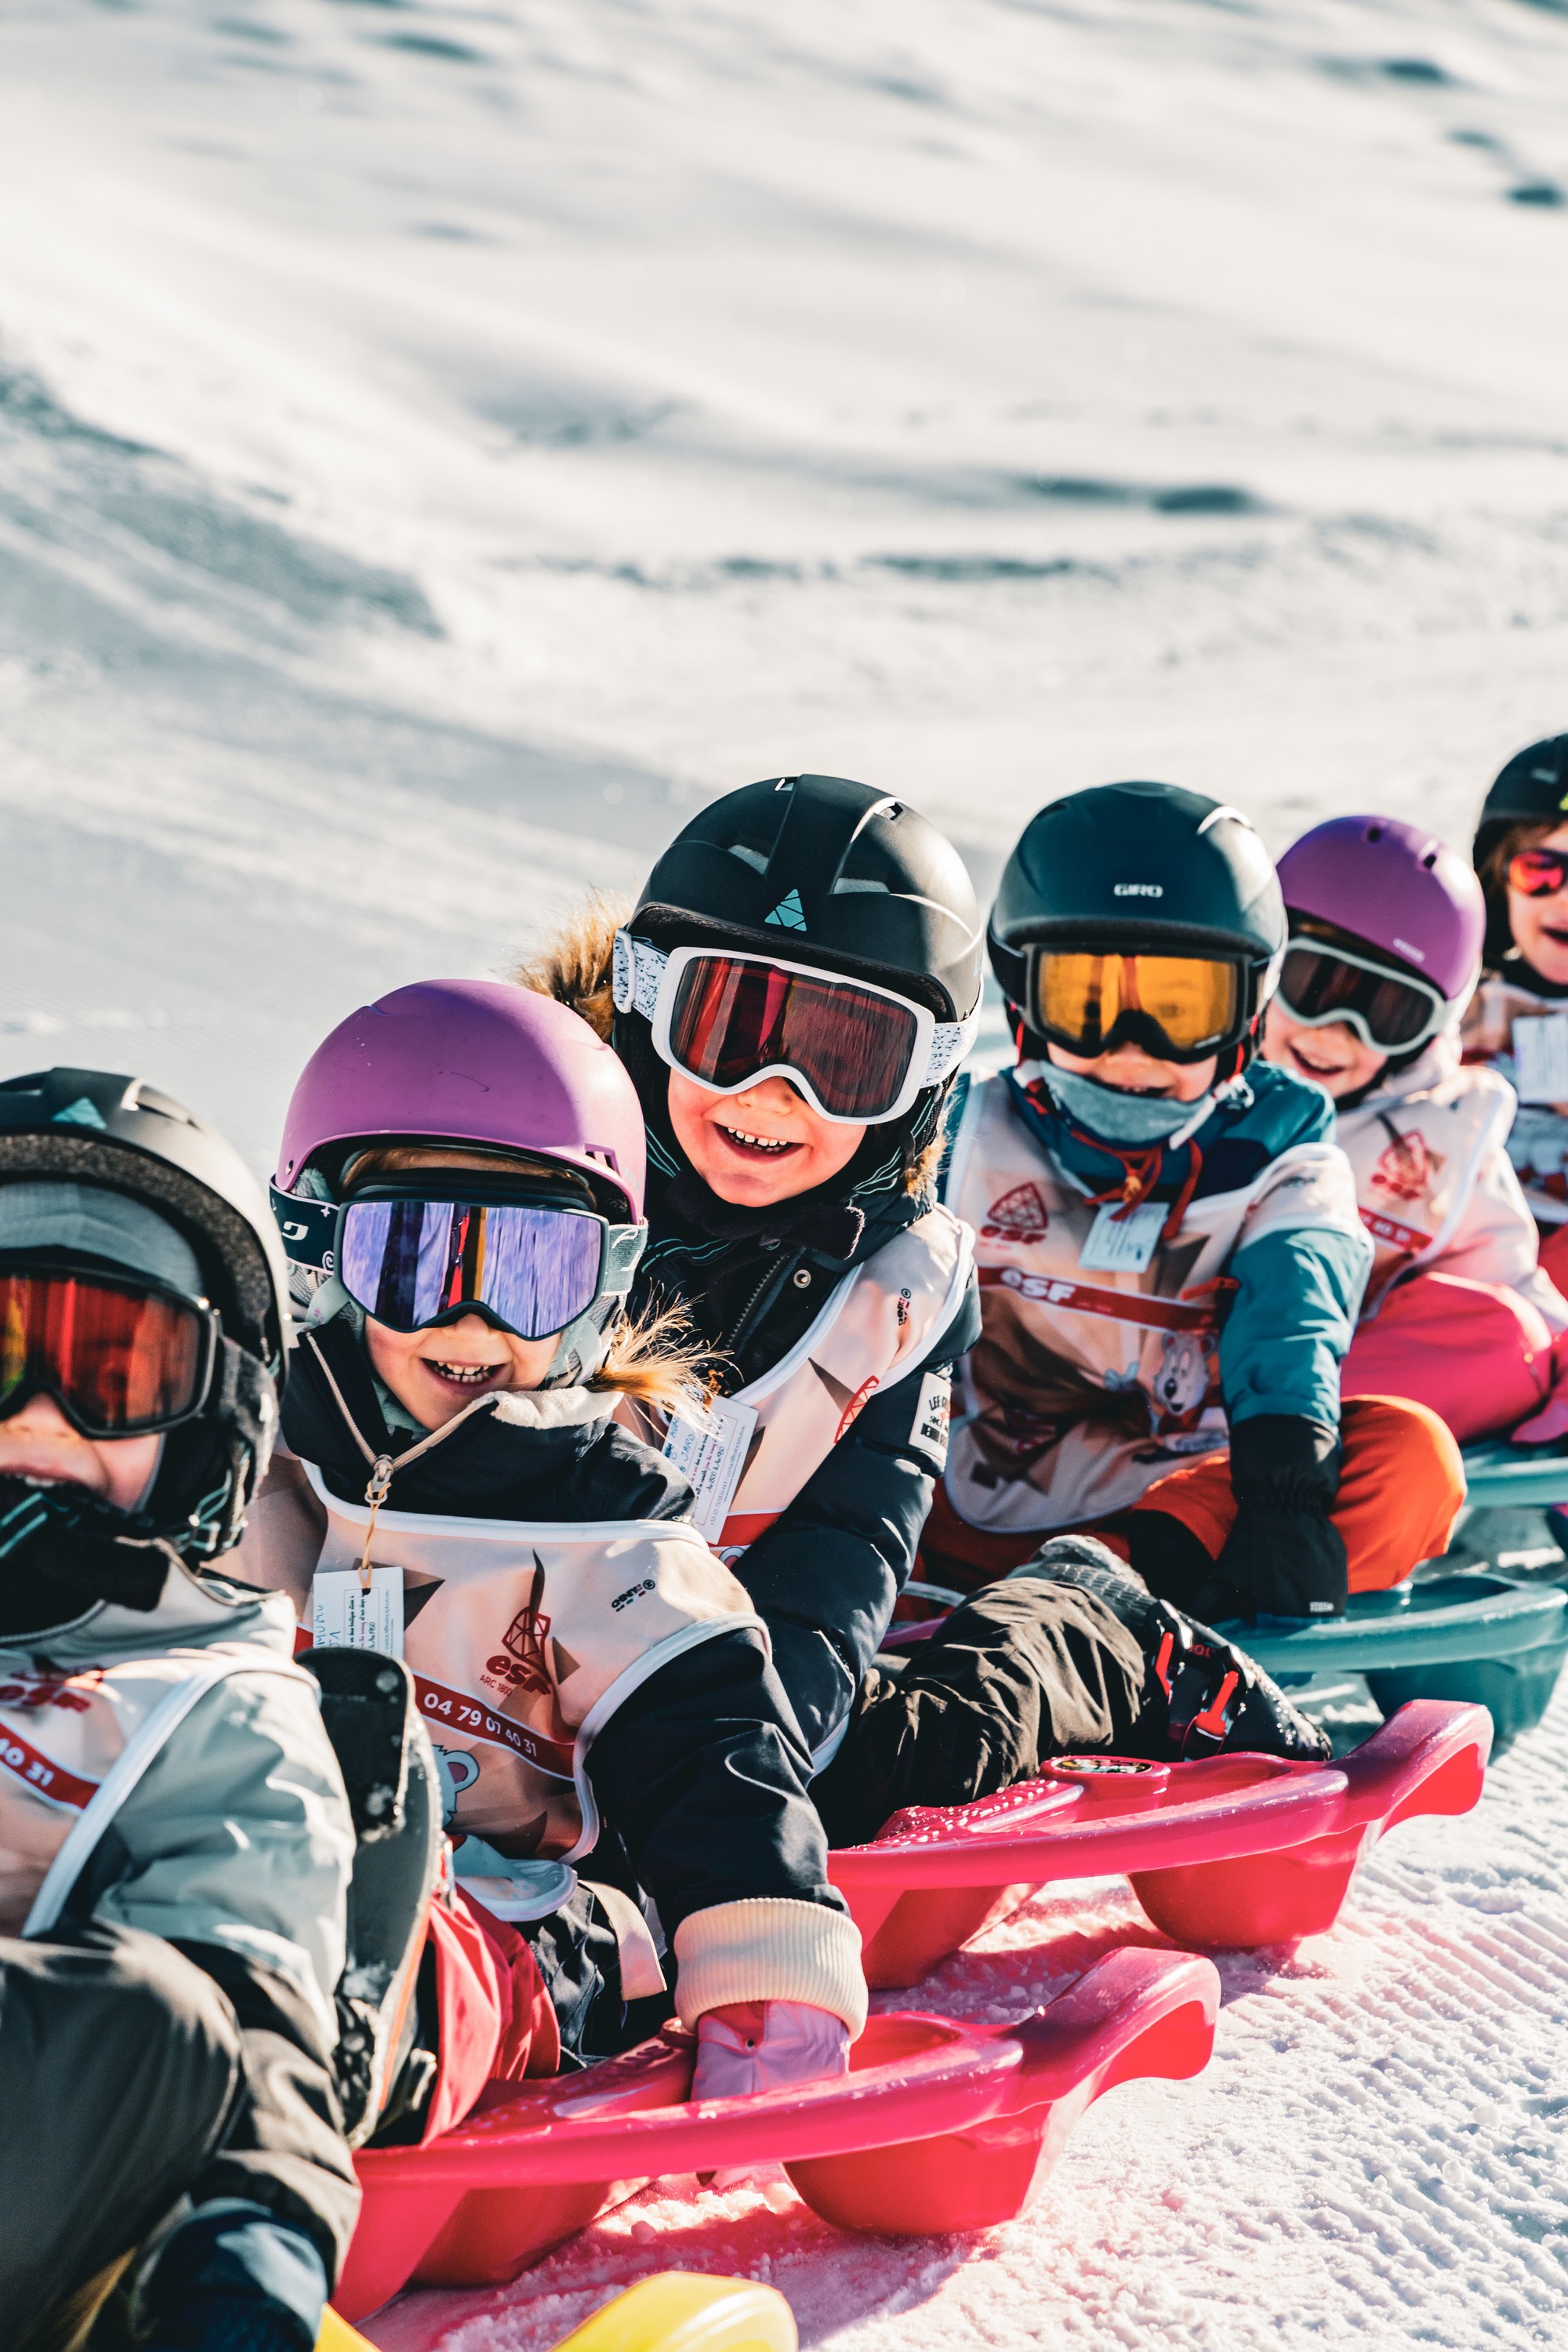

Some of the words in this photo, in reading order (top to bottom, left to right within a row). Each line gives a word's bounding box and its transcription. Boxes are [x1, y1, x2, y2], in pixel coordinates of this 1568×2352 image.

[1114, 884, 1163, 898] GIRO
[479, 1675, 496, 1688] ARC
[424, 1693, 452, 1715] 04
[456, 1705, 481, 1726] 79
[485, 1716, 502, 1734] 07
[506, 1730, 521, 1747] 40
[524, 1739, 537, 1757] 31
[25, 1761, 54, 1787] 31
